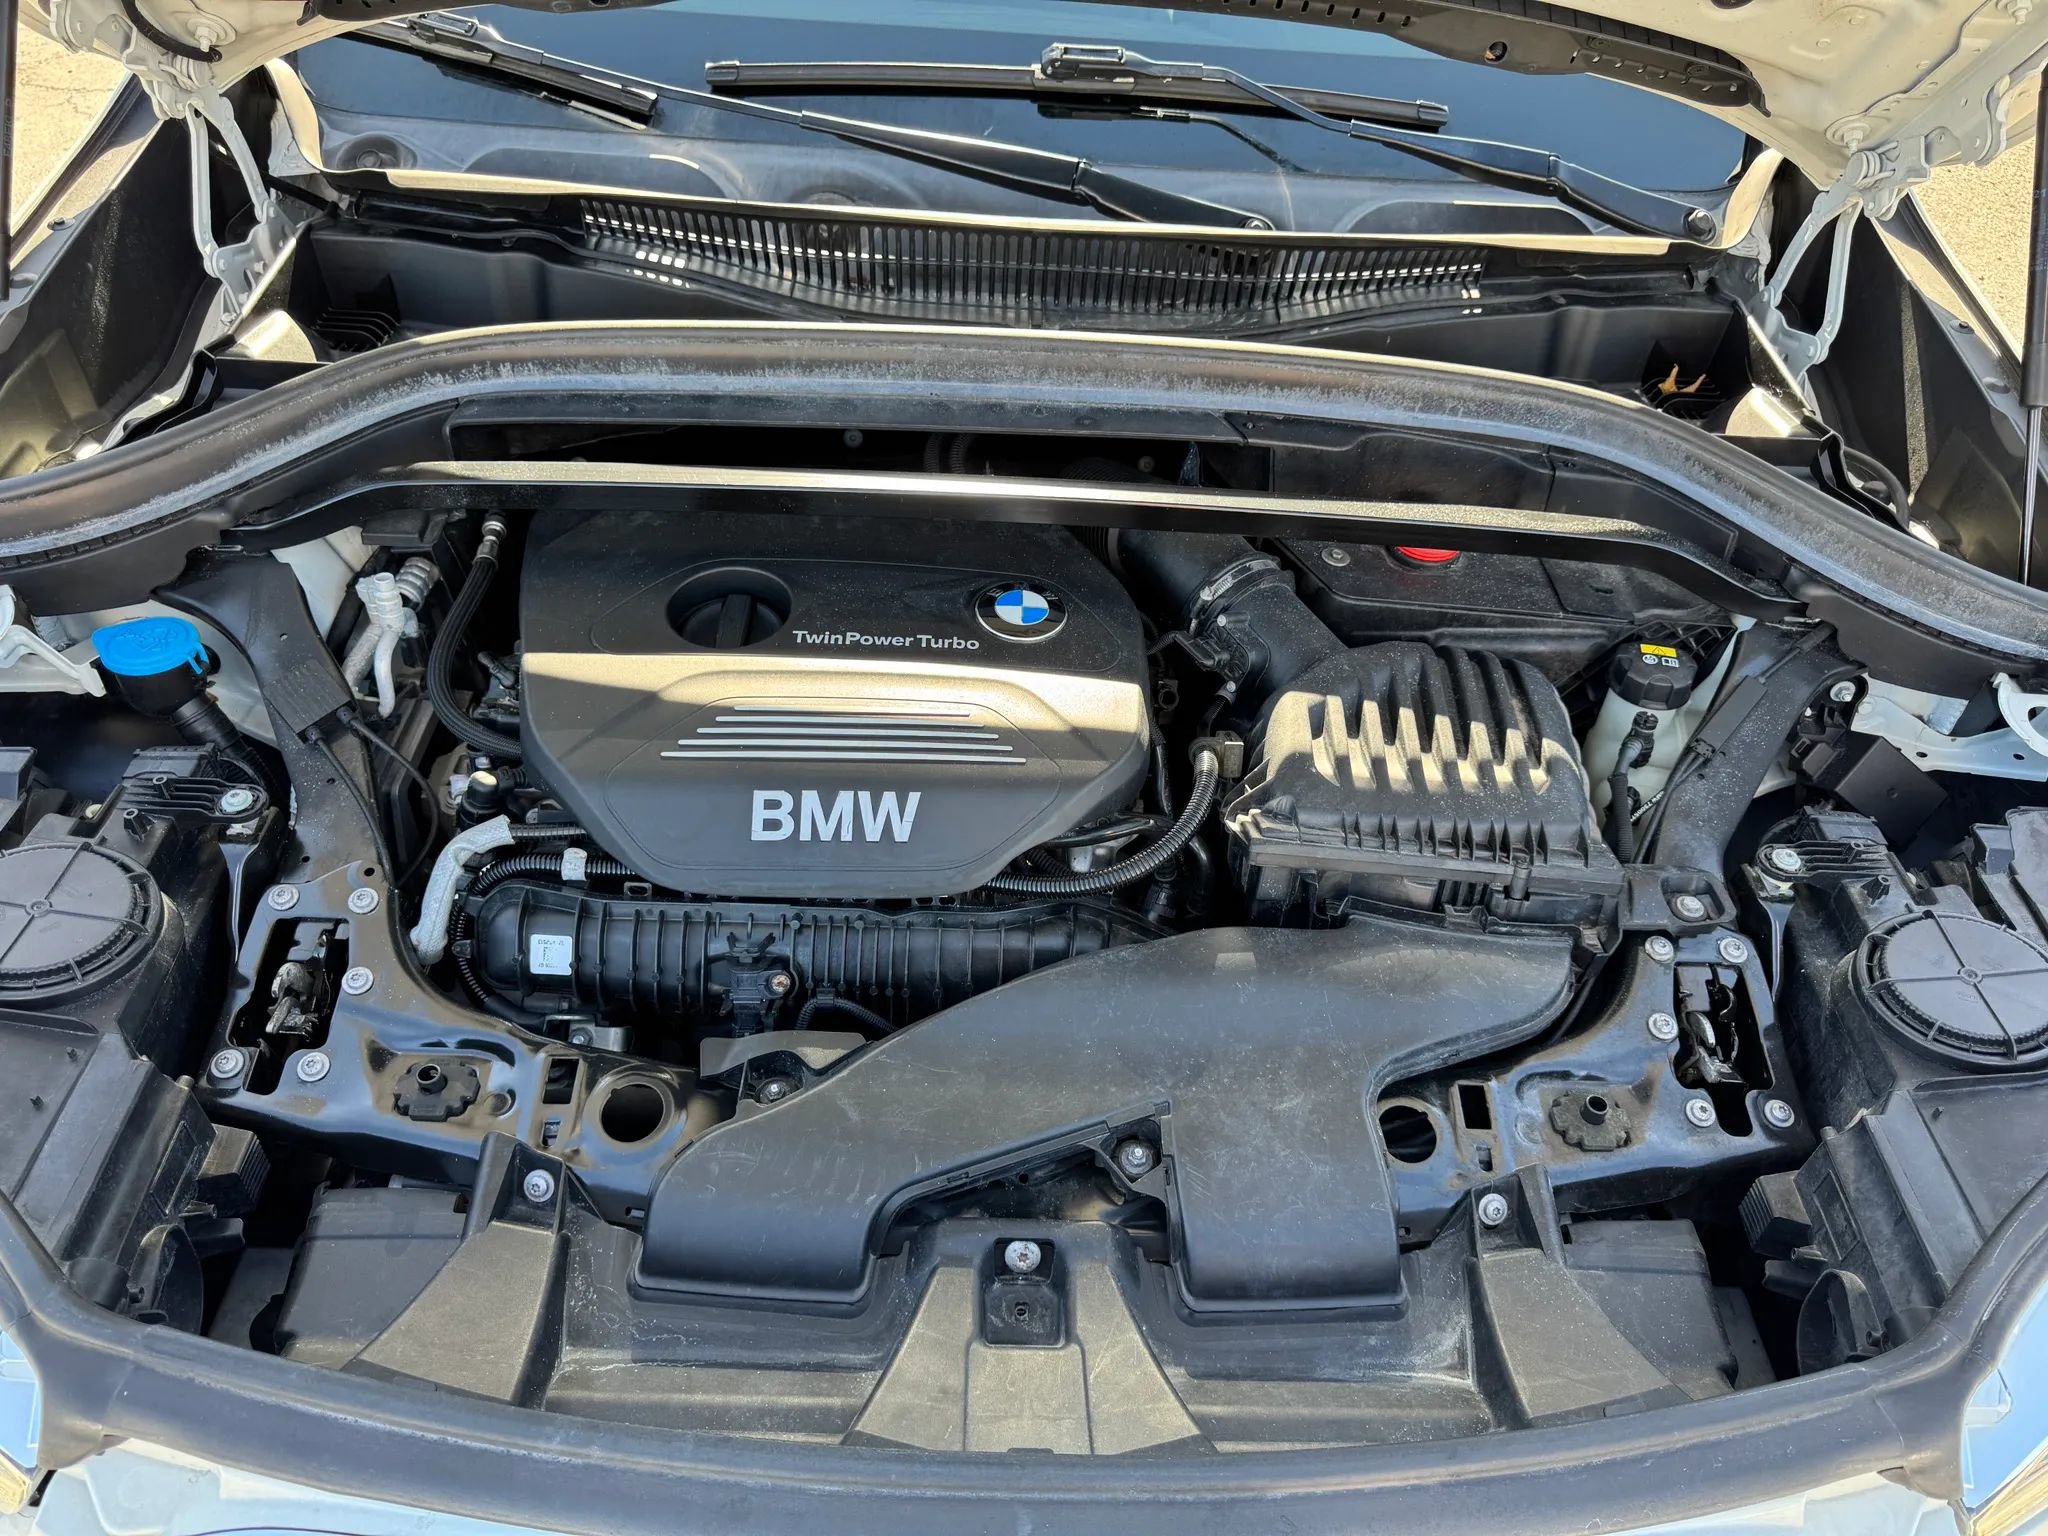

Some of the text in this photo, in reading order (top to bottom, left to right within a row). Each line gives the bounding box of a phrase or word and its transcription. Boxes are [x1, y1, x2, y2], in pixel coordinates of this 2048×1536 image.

[792, 630, 980, 650] TwinPower Turbo
[751, 789, 922, 842] BMW
